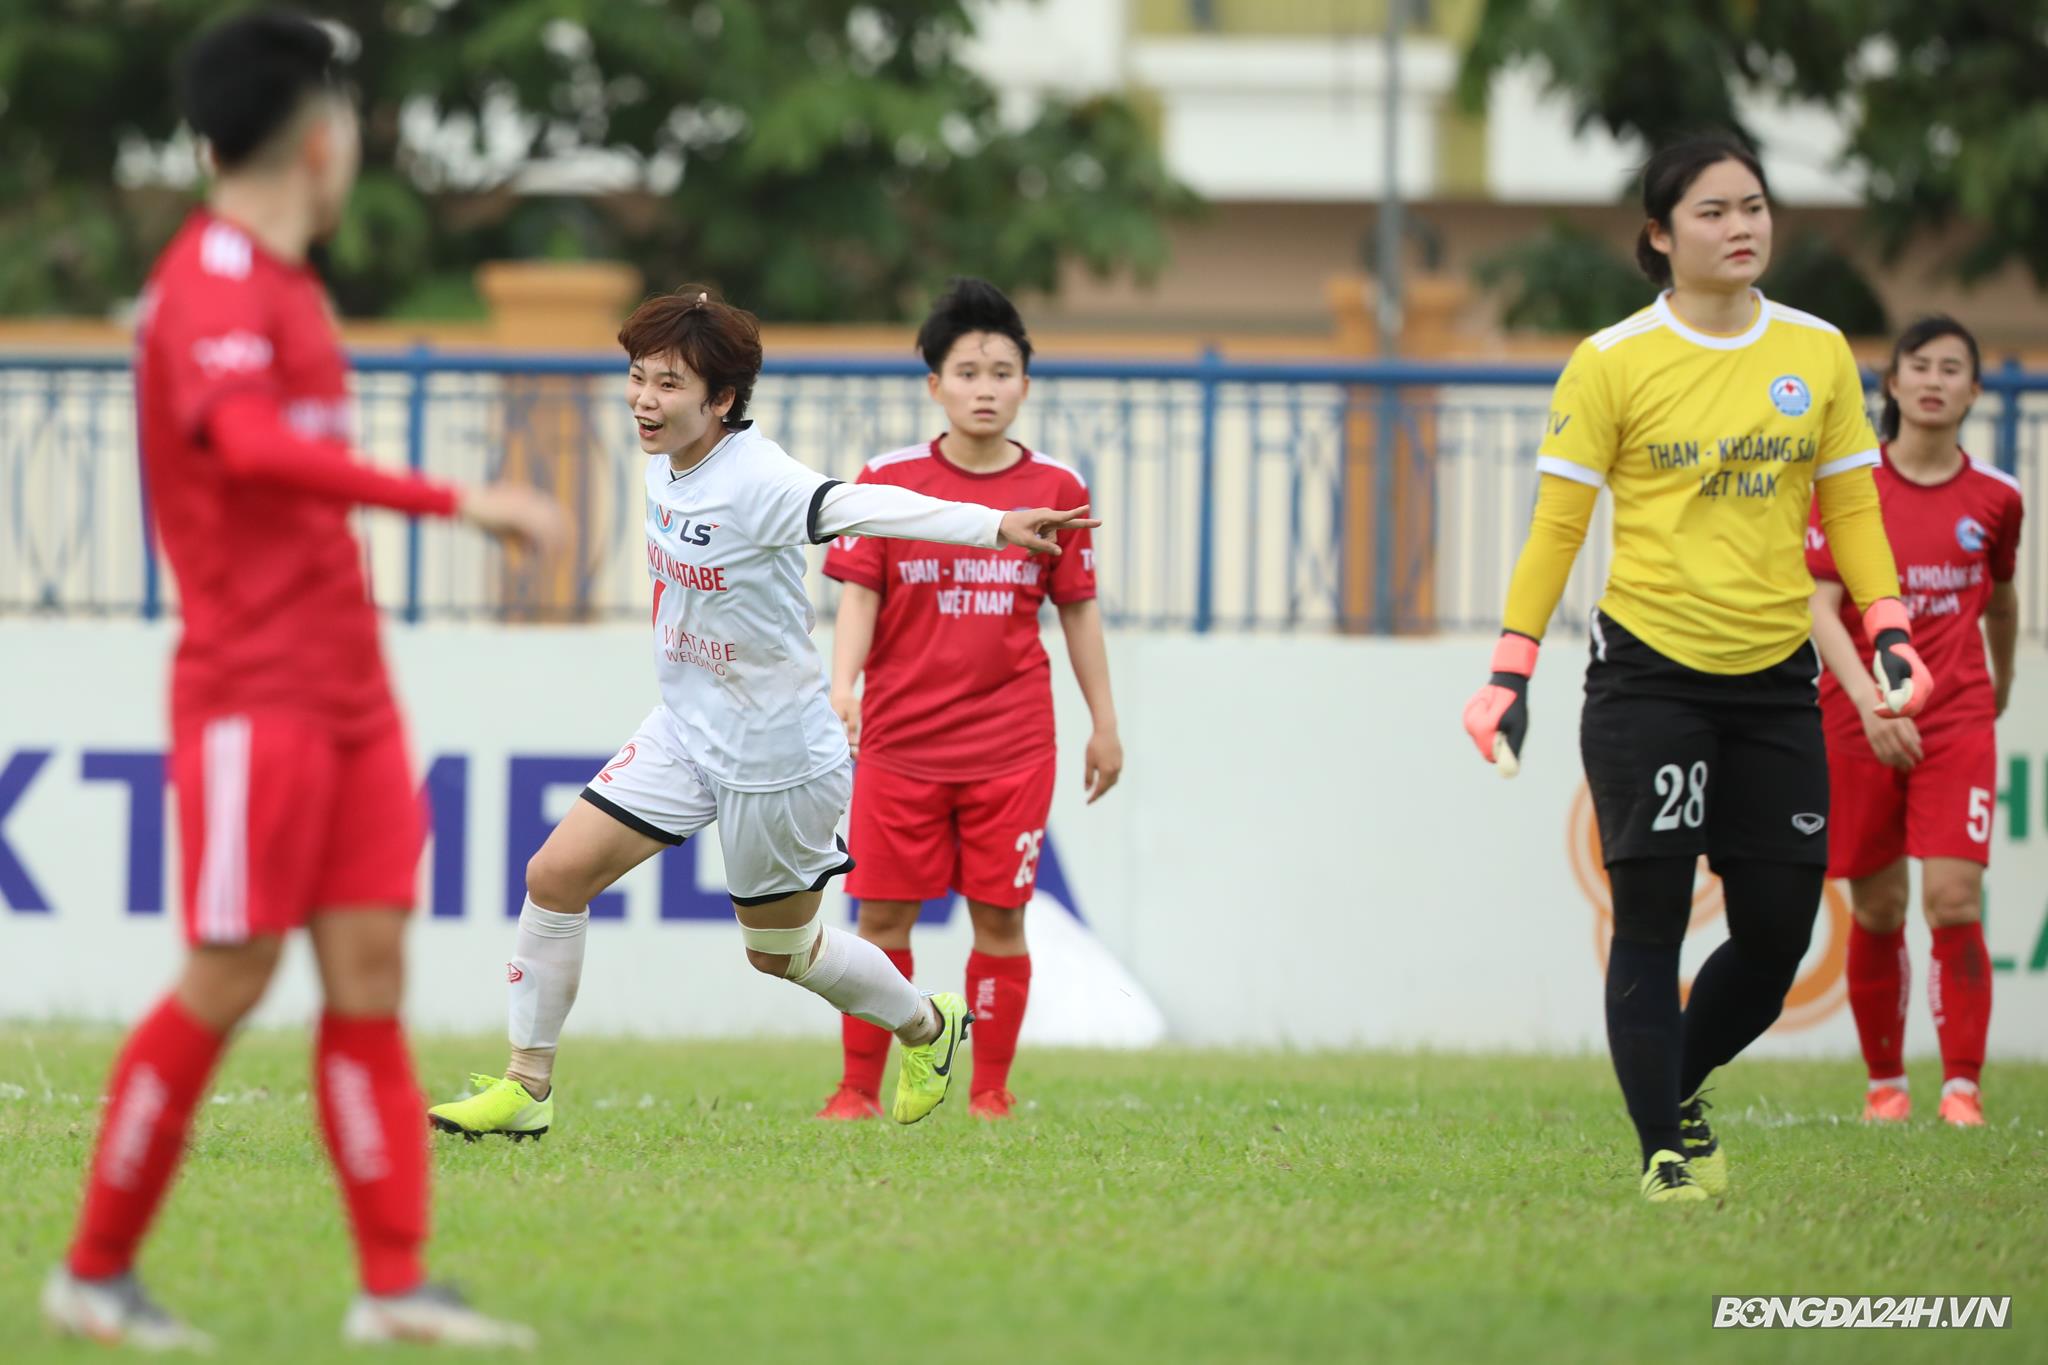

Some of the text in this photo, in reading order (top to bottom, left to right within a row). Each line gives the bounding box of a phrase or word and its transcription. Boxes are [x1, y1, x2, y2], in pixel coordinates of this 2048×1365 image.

[1648, 441, 1698, 469] THAN
[680, 519, 712, 546] LS
[664, 552, 728, 591] WATABE
[897, 558, 940, 584] THAN
[974, 591, 1015, 616] NAM
[665, 624, 737, 661] WATABE
[665, 649, 726, 676] WEDDING
[1652, 761, 1708, 831] 28
[1967, 786, 1990, 843] 5
[1014, 828, 1044, 888] 25
